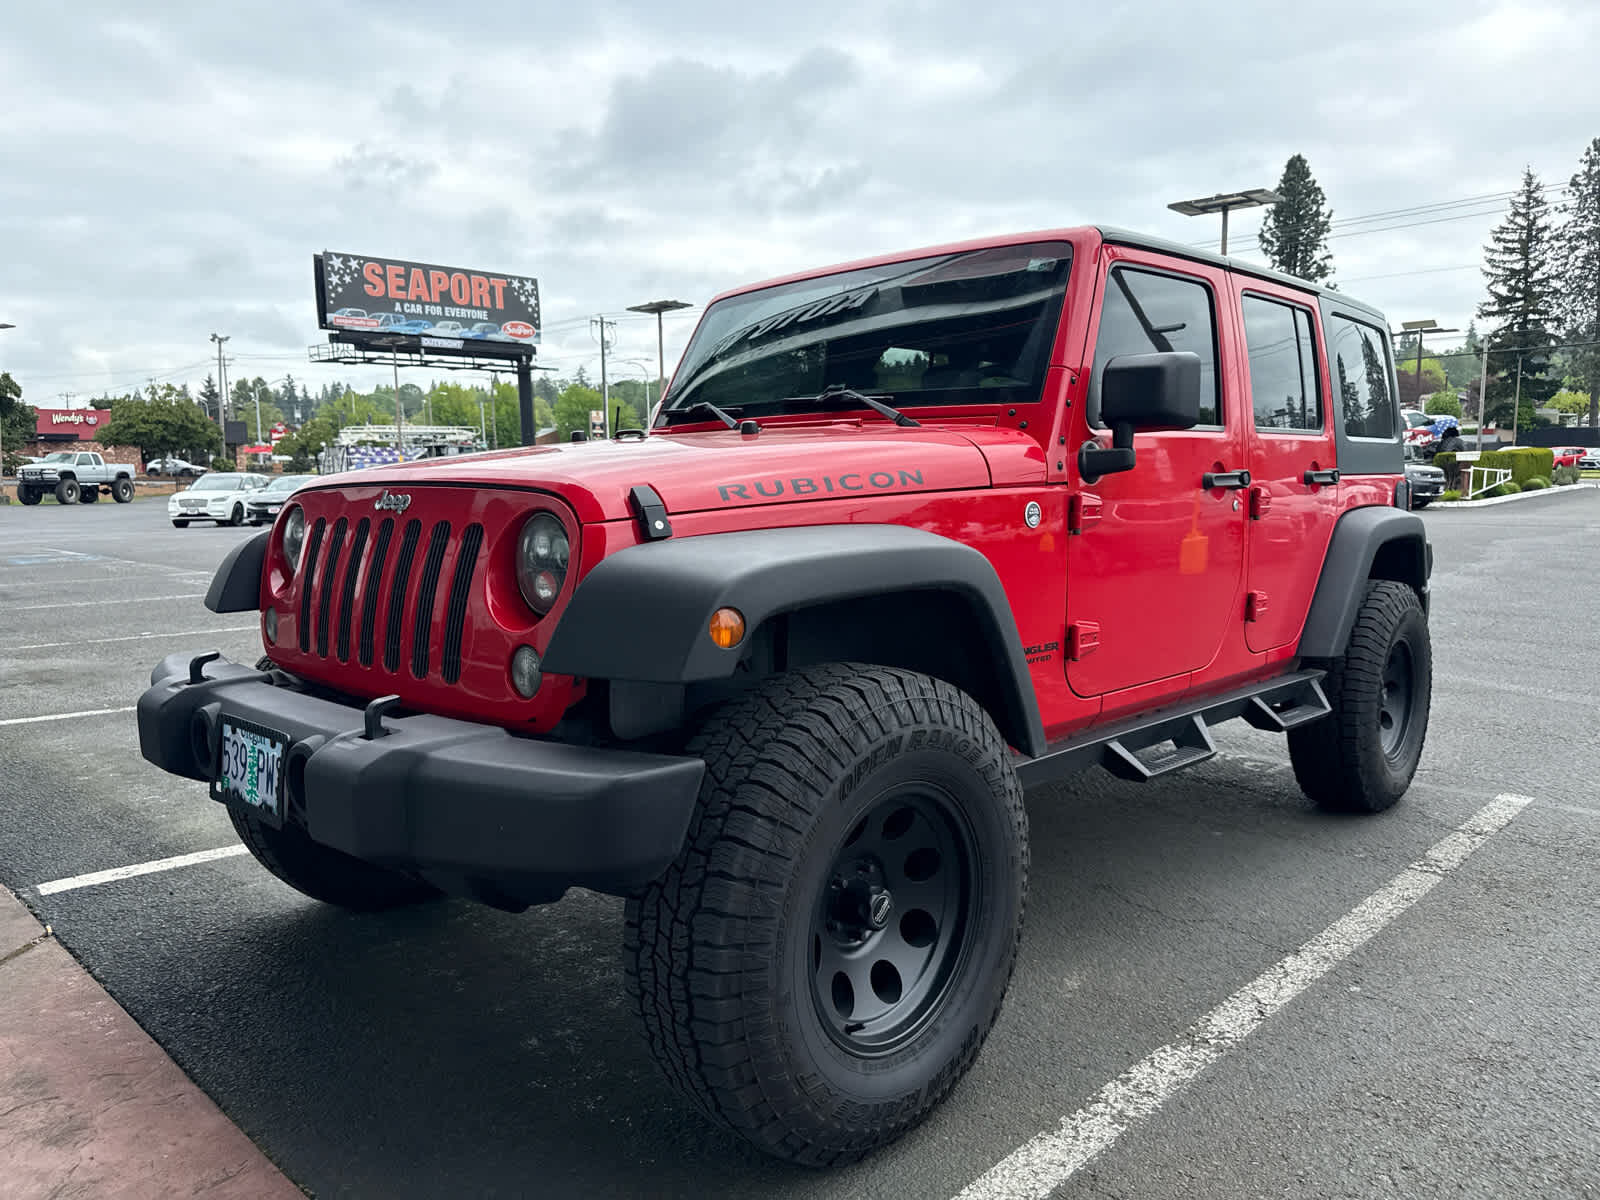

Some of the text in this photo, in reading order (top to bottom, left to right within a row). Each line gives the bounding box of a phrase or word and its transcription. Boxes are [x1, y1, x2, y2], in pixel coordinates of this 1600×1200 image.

[363, 262, 507, 310] SEAPORT
[395, 302, 489, 321] A CAR FOR EVERYONE
[52, 412, 84, 425] Wendy's
[717, 469, 924, 501] RUBICON
[375, 490, 411, 514] Jeep
[1024, 642, 1059, 655] NGLER
[223, 736, 247, 782] 539
